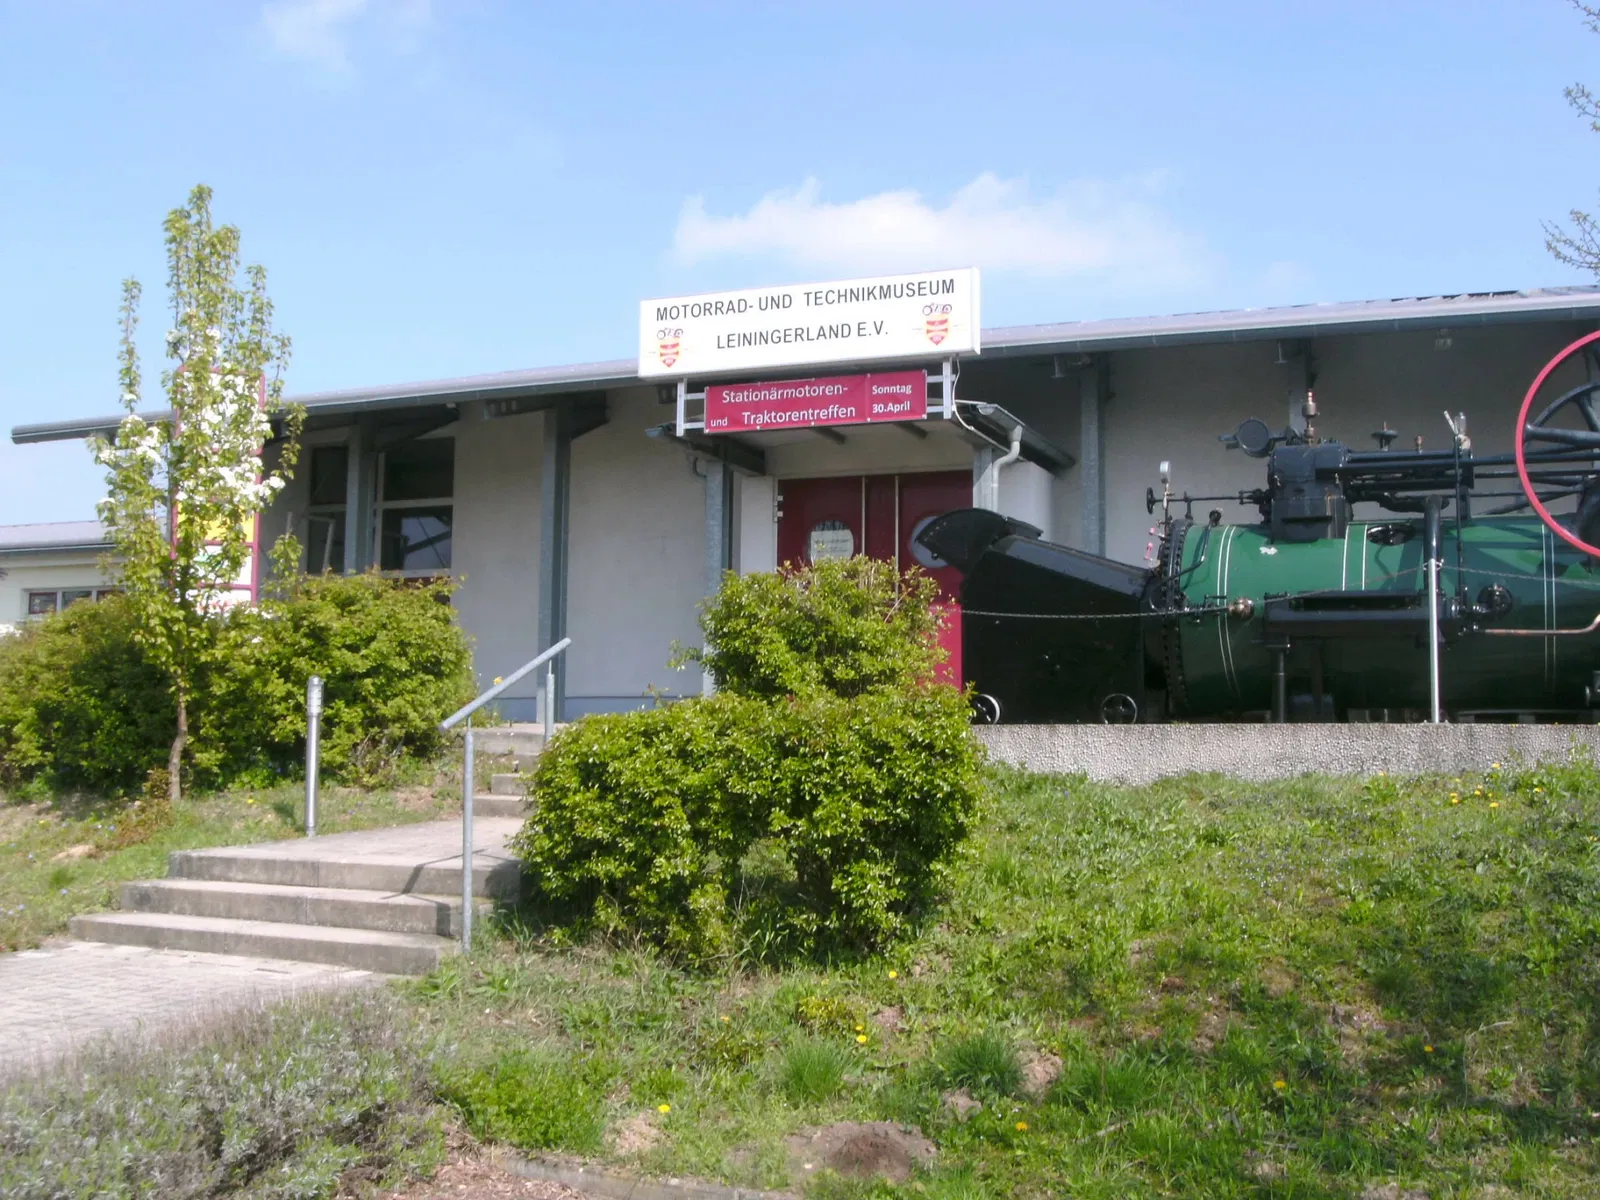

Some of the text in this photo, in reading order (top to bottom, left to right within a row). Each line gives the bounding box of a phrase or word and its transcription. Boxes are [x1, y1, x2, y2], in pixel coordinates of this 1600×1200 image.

[656, 278, 955, 321] MOTORRAD- UND TECHNIKMUSEUM
[716, 320, 888, 349] LEININGERLAND E.V.
[722, 384, 848, 403] Stationärmotoren-
[872, 383, 912, 396] Sonntag
[710, 404, 856, 427] und Traktorentreffen
[872, 401, 911, 414] 30.April
